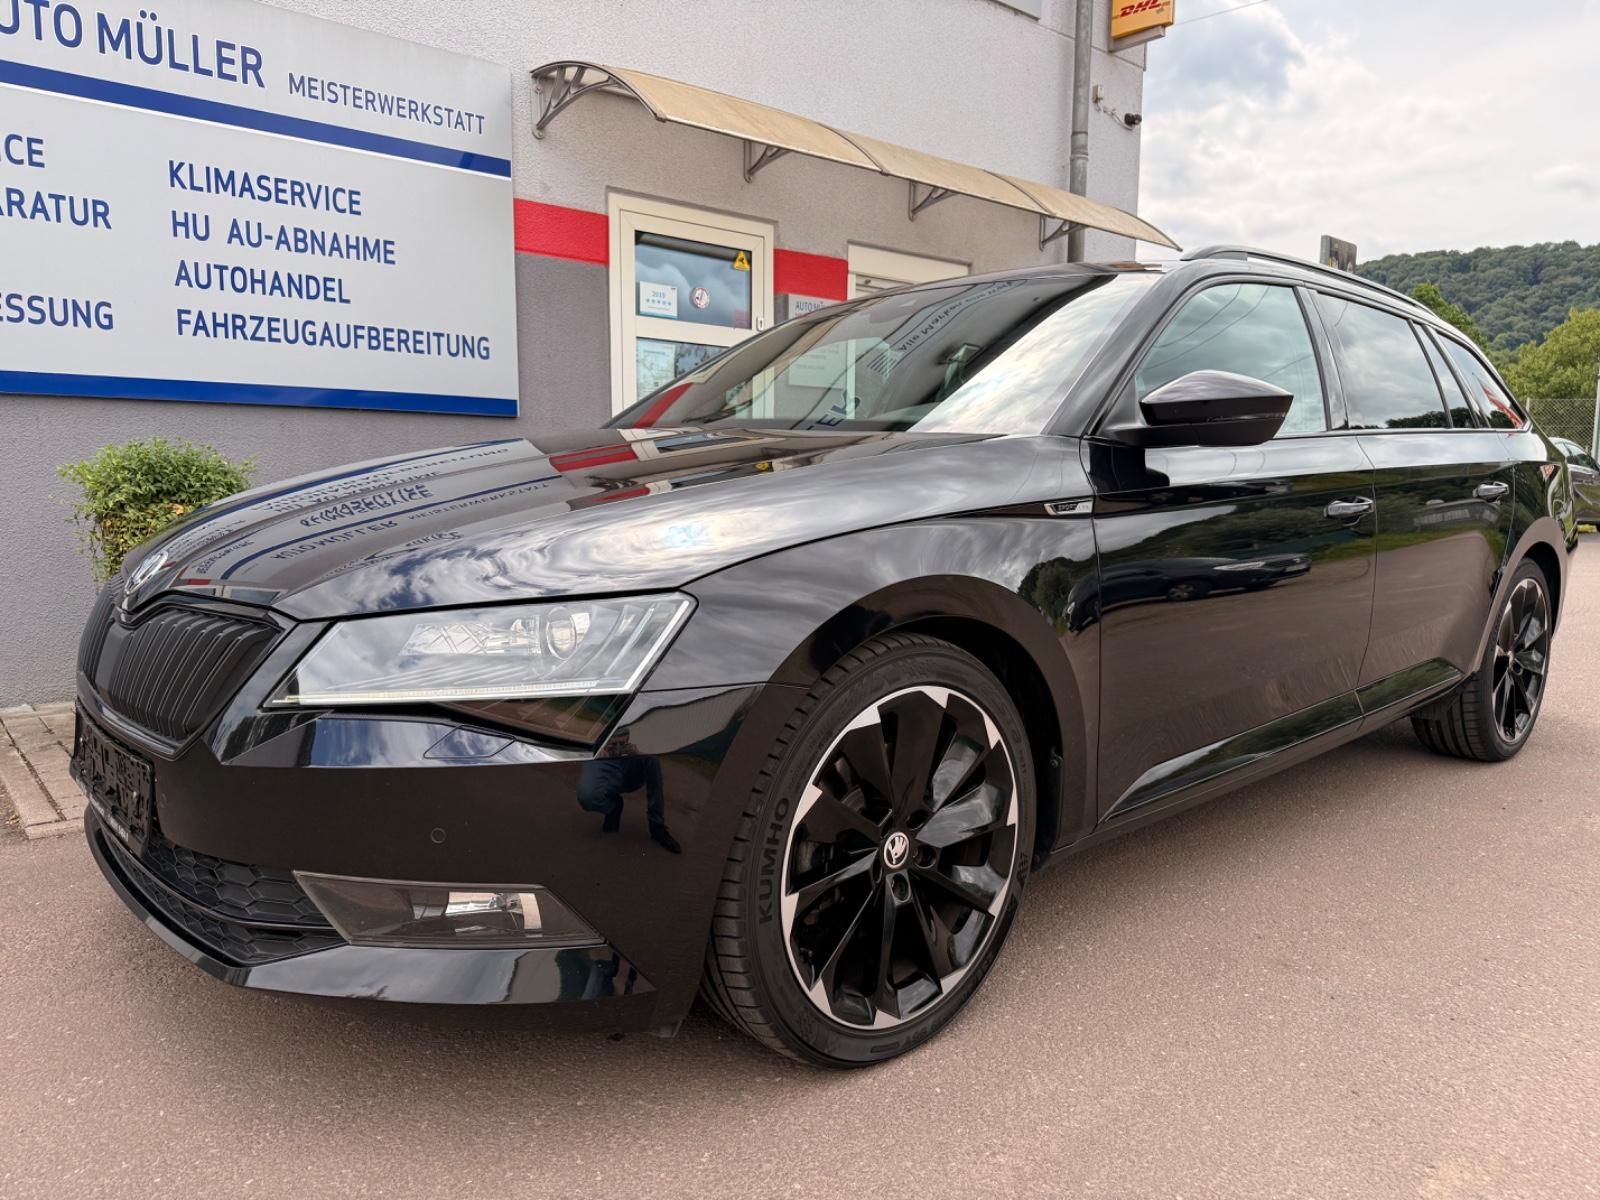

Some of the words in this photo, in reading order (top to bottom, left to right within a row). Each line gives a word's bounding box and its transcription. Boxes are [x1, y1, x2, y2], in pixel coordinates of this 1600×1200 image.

[1120, 0, 1161, 17] DHL
[96, 10, 265, 88] MÜLLER
[288, 72, 485, 135] MEISTERWERKSTATT
[0, 133, 46, 168] CE
[168, 159, 362, 216] KLIMASERVICE
[171, 210, 210, 241] HU
[227, 218, 396, 265] AU-ABNAHME
[175, 260, 352, 304] AUTOHANDEL
[0, 292, 114, 331] SSUNG
[175, 308, 491, 360] FAHRZEUGAUFBEREITUNG
[759, 797, 790, 924] KUMHO
